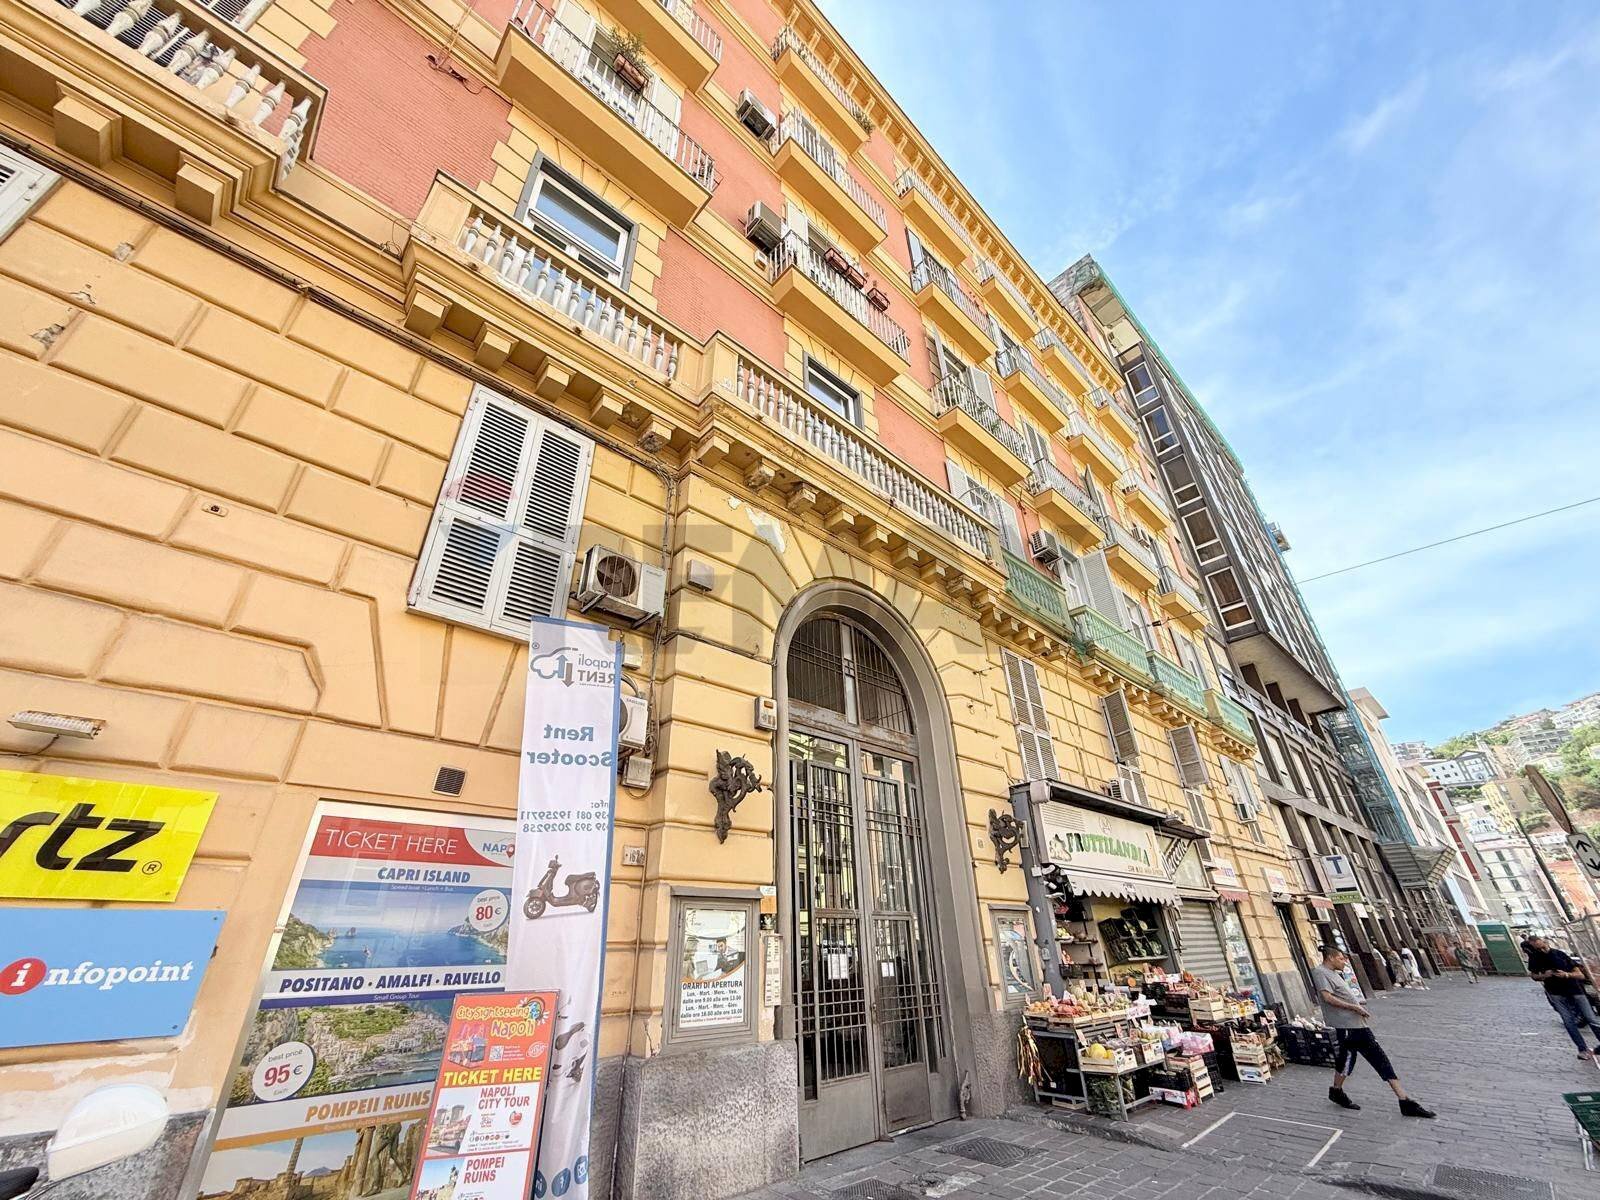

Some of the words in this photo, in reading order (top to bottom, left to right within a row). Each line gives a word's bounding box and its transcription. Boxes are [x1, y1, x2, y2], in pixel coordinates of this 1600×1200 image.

[326, 829, 403, 851] TICKET
[405, 835, 459, 855] HERE
[1325, 855, 1342, 874] T
[377, 866, 421, 882] CAPRI
[422, 868, 471, 883] ISLAND
[475, 905, 493, 921] 80
[11, 959, 194, 991] infopoint
[279, 976, 364, 993] POSITANO
[376, 973, 432, 989] AMALFI
[443, 971, 501, 986] RAVELLO
[682, 981, 702, 990] ORARI
[703, 981, 710, 989] DI
[711, 980, 743, 988] APERTURA
[389, 993, 407, 1002] Group
[407, 992, 420, 1000] Tour
[490, 1020, 535, 1040] Napoli
[263, 1063, 291, 1088] 95
[443, 1068, 500, 1087] TICKET
[502, 1067, 543, 1082] HERE
[480, 1086, 516, 1098] NAPOLI
[305, 1097, 380, 1122] POMPEII
[383, 1091, 431, 1111] RUINS
[478, 1097, 504, 1110] CITY
[504, 1095, 530, 1108] TOUR
[466, 1156, 505, 1171] POMPEI
[463, 1169, 496, 1184] RUINS
